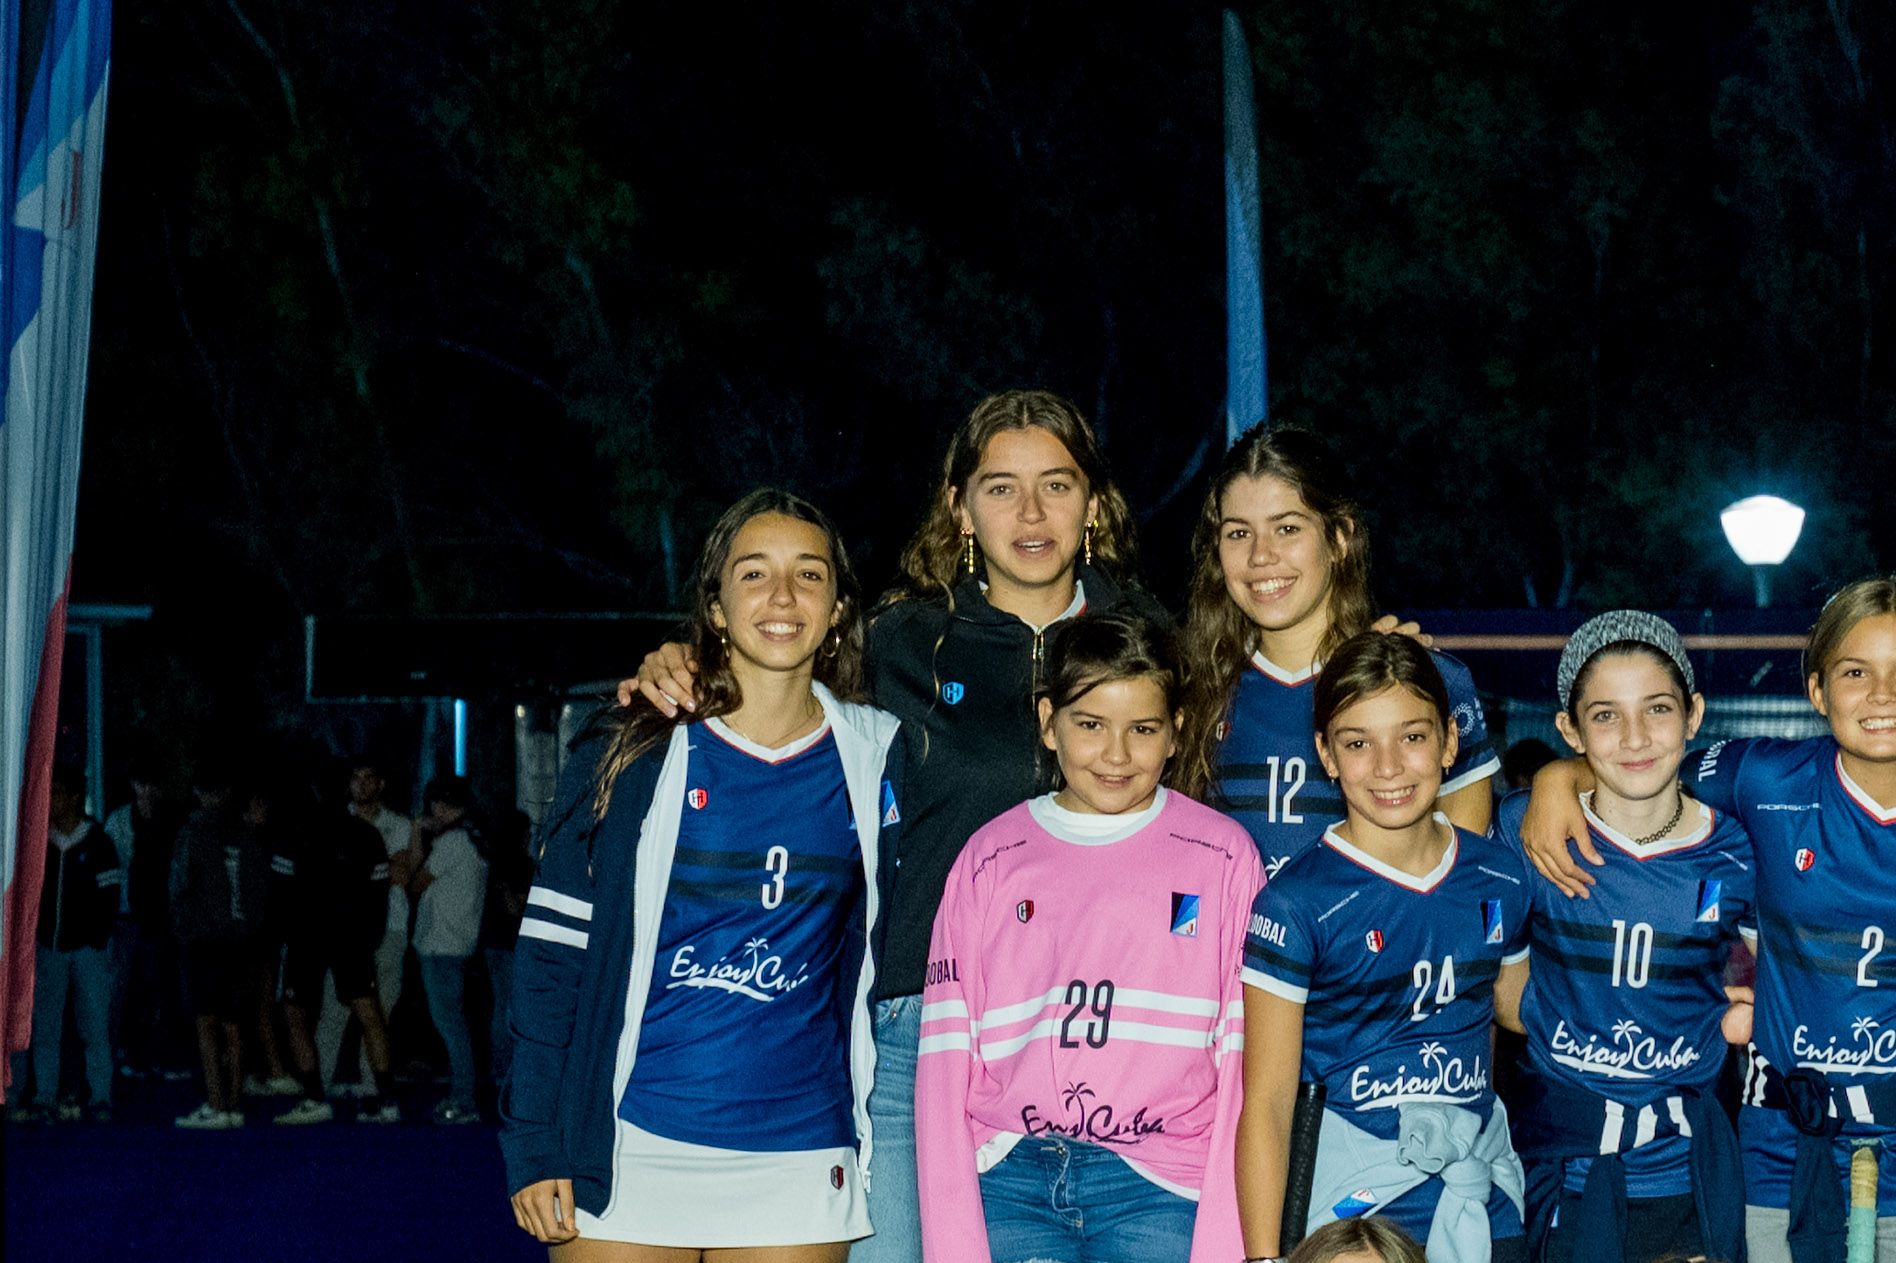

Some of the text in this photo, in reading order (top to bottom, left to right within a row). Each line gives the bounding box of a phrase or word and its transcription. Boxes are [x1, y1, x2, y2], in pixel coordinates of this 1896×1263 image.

[1266, 755, 1307, 823] 12
[761, 846, 789, 910] 3
[755, 955, 809, 992] Cu
[1611, 919, 1654, 988] 10
[1856, 925, 1884, 987] 2
[1059, 979, 1115, 1049] 29
[1411, 955, 1457, 1021] 24
[1793, 1024, 1872, 1075] Enjoy
[1351, 1065, 1441, 1107] Enjoy
